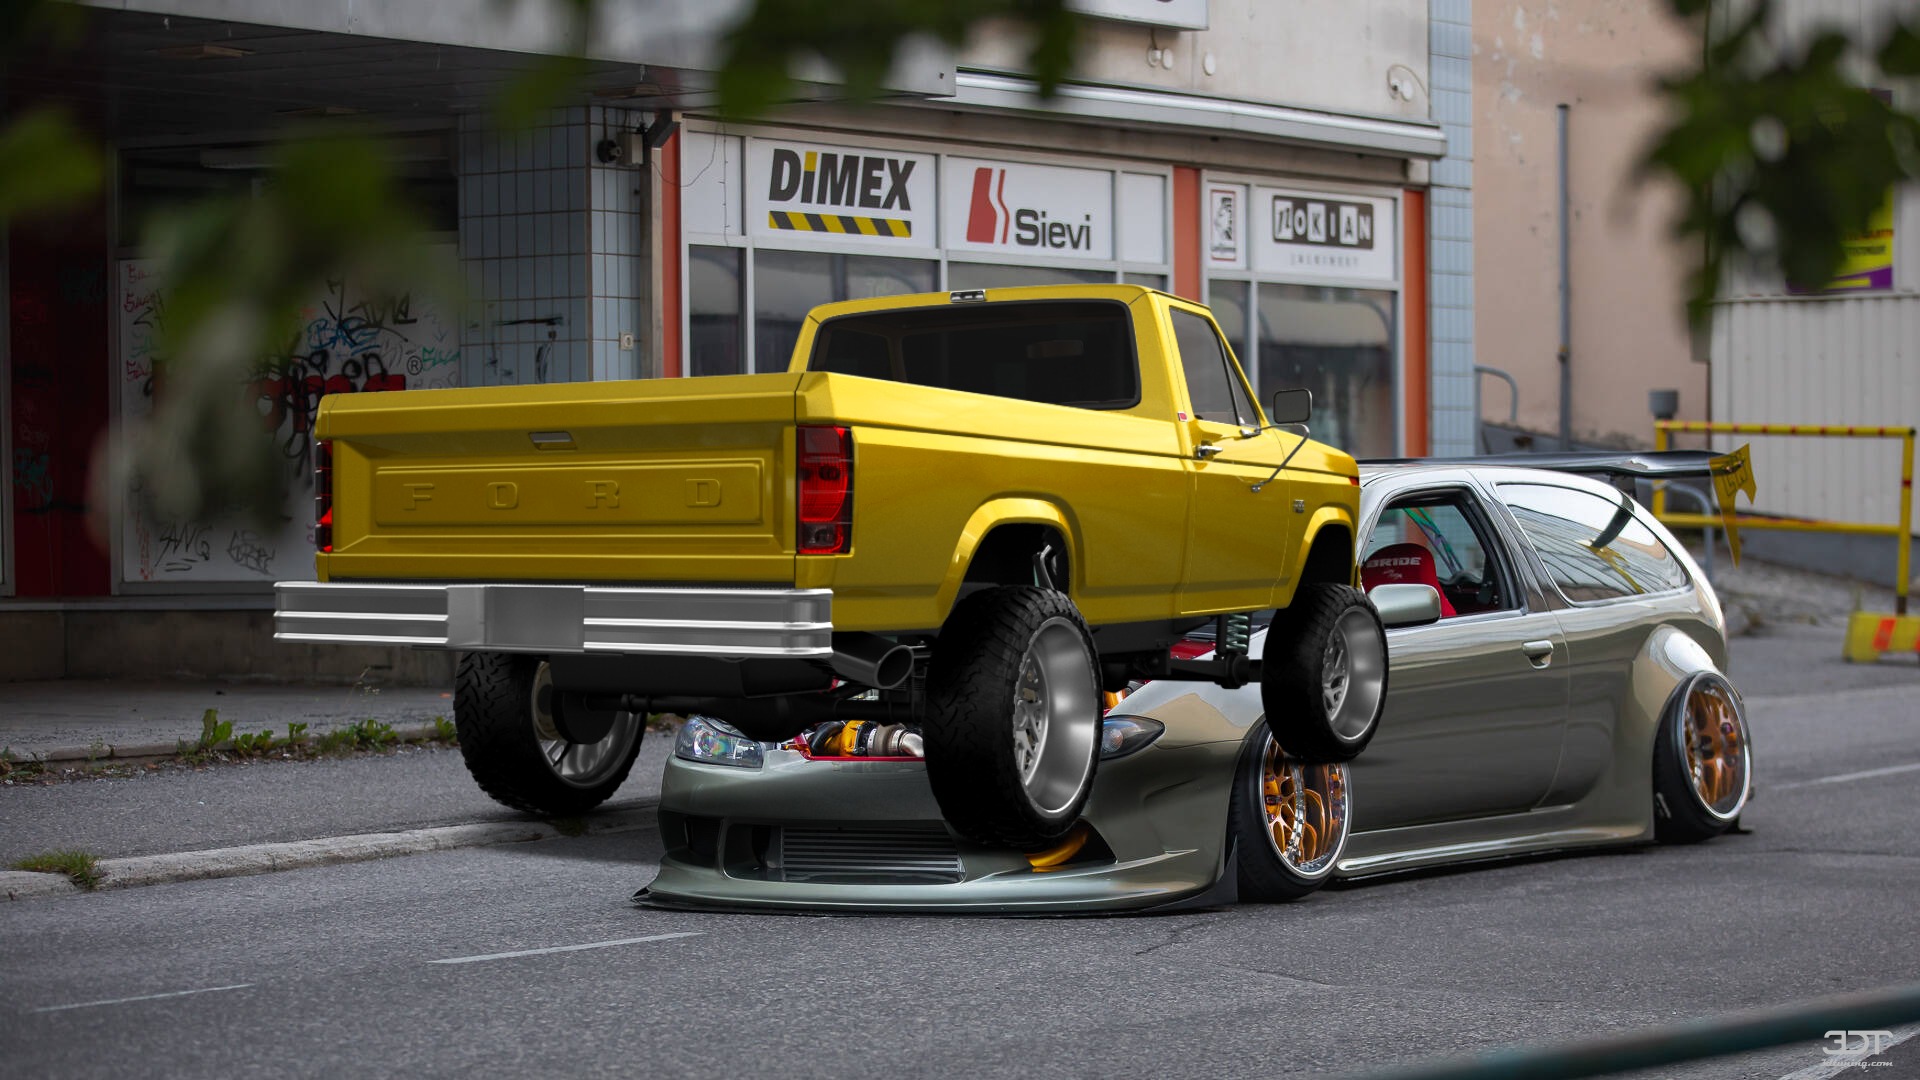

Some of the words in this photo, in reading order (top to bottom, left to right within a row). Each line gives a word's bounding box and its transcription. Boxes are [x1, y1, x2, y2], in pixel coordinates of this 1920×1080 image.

[1015, 208, 1092, 250] Sievi
[1276, 202, 1371, 243] NOKIAN
[403, 478, 721, 511] FORD
